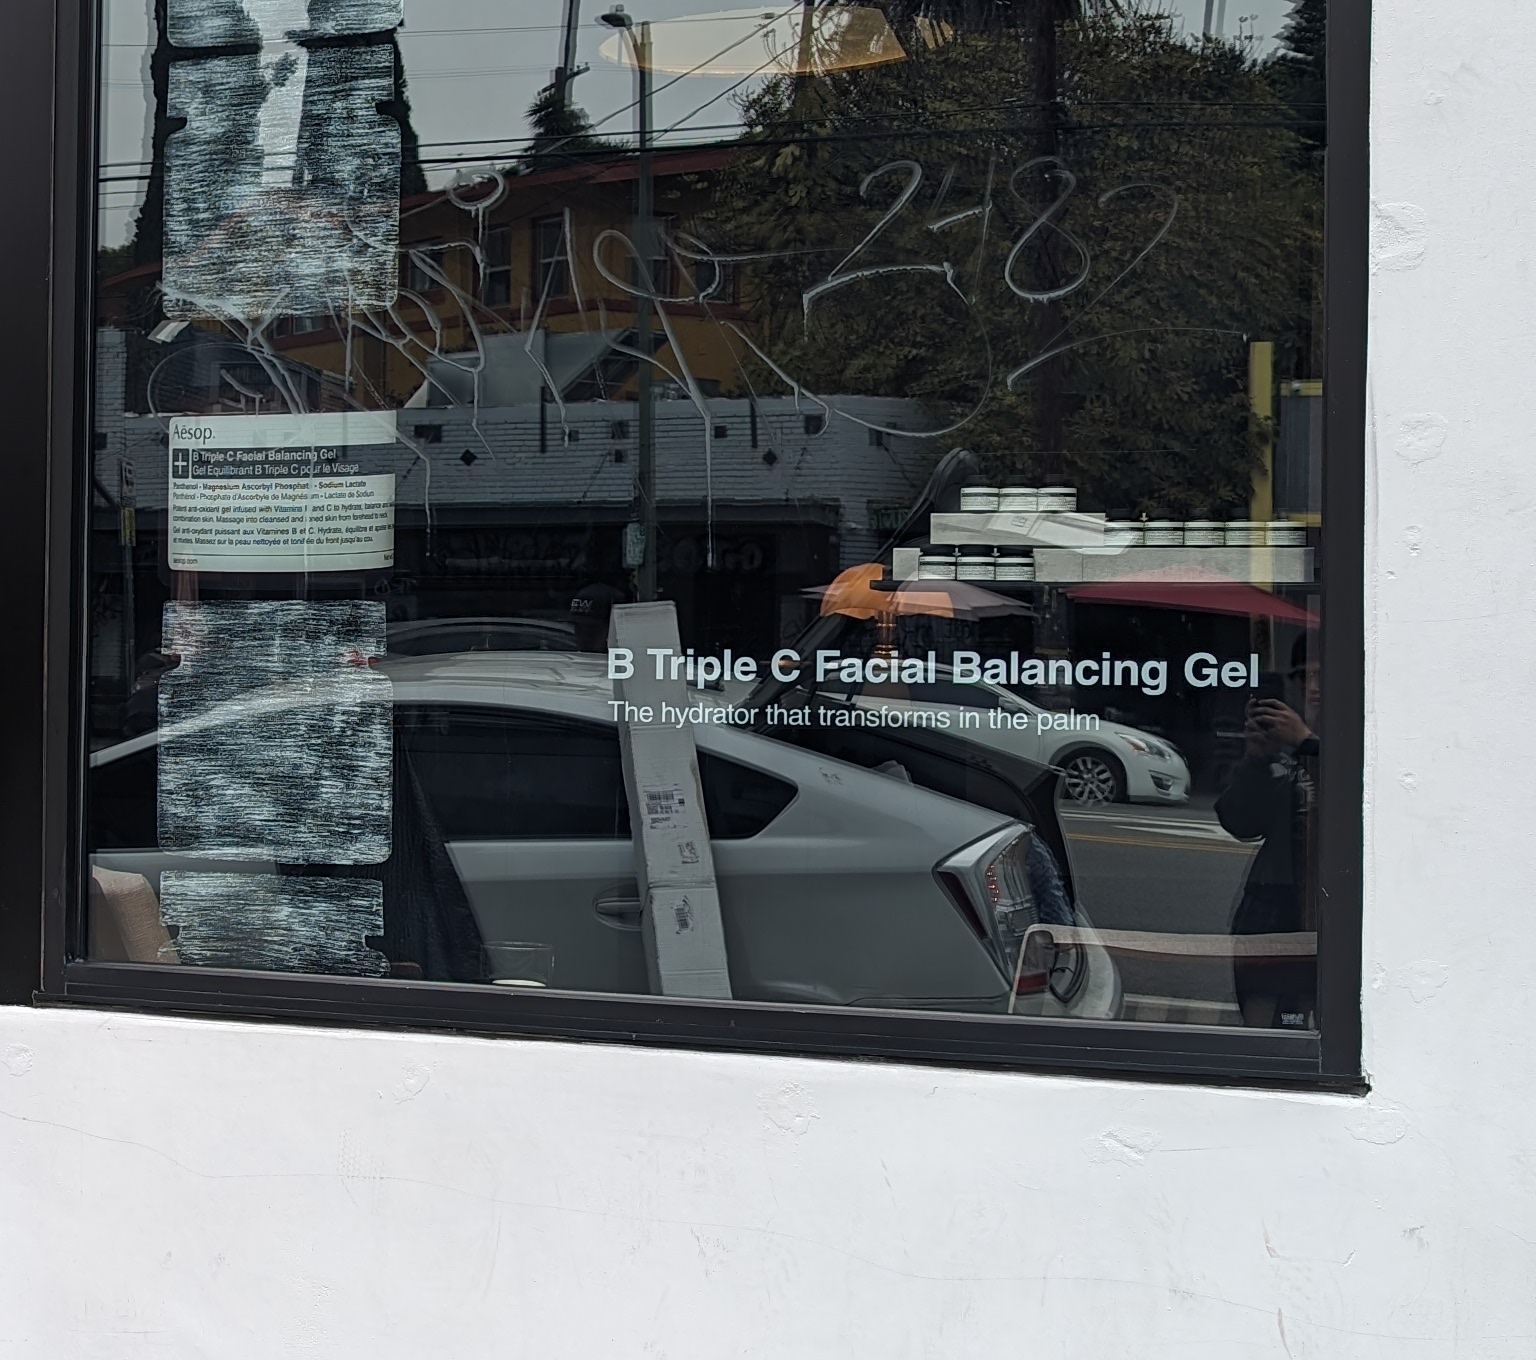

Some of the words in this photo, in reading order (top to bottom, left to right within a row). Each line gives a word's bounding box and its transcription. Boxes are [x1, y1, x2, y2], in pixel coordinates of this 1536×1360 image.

[192, 451, 199, 461] B
[202, 451, 224, 462] Triple
[226, 451, 234, 460] C
[236, 450, 265, 461] Facial
[268, 450, 318, 462] Balancing
[320, 449, 337, 459] Gel
[192, 465, 206, 475] Gel
[255, 465, 262, 474] B
[264, 465, 288, 476] Triple
[291, 464, 299, 474] C
[323, 463, 330, 473] le
[332, 463, 359, 475] Visage
[203, 482, 240, 492] Magnesium
[242, 483, 273, 492] Ascorbyl
[319, 481, 343, 489] Sodium
[345, 480, 366, 488] Lactate
[324, 491, 346, 499] Lactate
[221, 506, 231, 514] gel
[233, 505, 257, 513] infused
[259, 505, 272, 513] with
[312, 504, 324, 512] and
[326, 504, 333, 512] C
[216, 515, 244, 524] Massage
[246, 515, 258, 523] into
[338, 513, 352, 521] from
[214, 528, 240, 536] puissant
[291, 527, 297, 535] B
[235, 539, 251, 547] peau
[316, 537, 324, 545] du
[325, 536, 339, 544] front
[607, 648, 635, 680] B
[646, 648, 757, 689] Triple
[771, 649, 801, 682] C
[816, 650, 936, 684] Facial
[951, 650, 1167, 696] Balancing
[1184, 652, 1259, 687] Gel
[607, 700, 654, 723] The
[661, 701, 759, 729] hydrator
[765, 703, 811, 726] that
[818, 705, 951, 729] transforms
[959, 706, 980, 729] in
[987, 707, 1029, 730] the
[1037, 708, 1100, 736] palm
